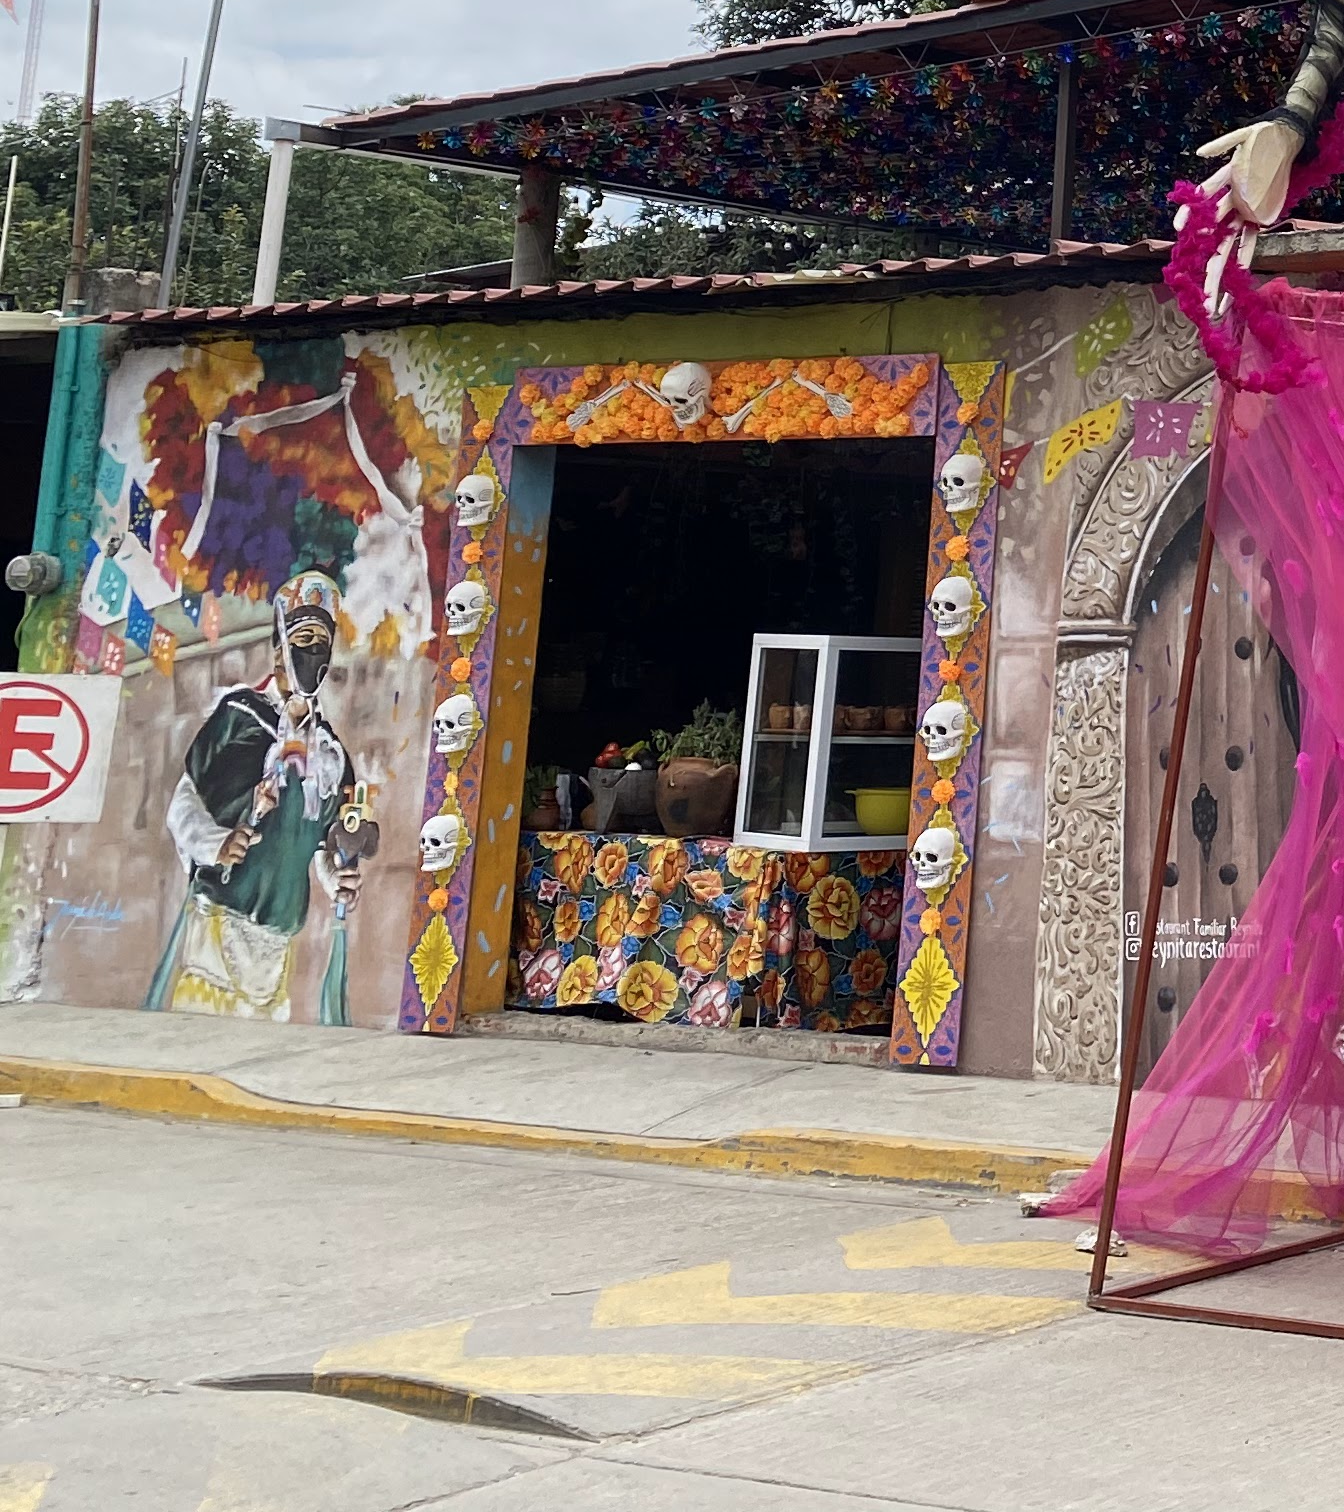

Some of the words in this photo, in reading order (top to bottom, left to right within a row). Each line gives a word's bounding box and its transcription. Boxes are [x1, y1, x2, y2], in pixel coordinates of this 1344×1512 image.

[0, 698, 62, 790] E
[1156, 918, 1191, 936] staurant
[1193, 918, 1227, 936] Familiar
[1152, 938, 1261, 968] eynitarestaurant
